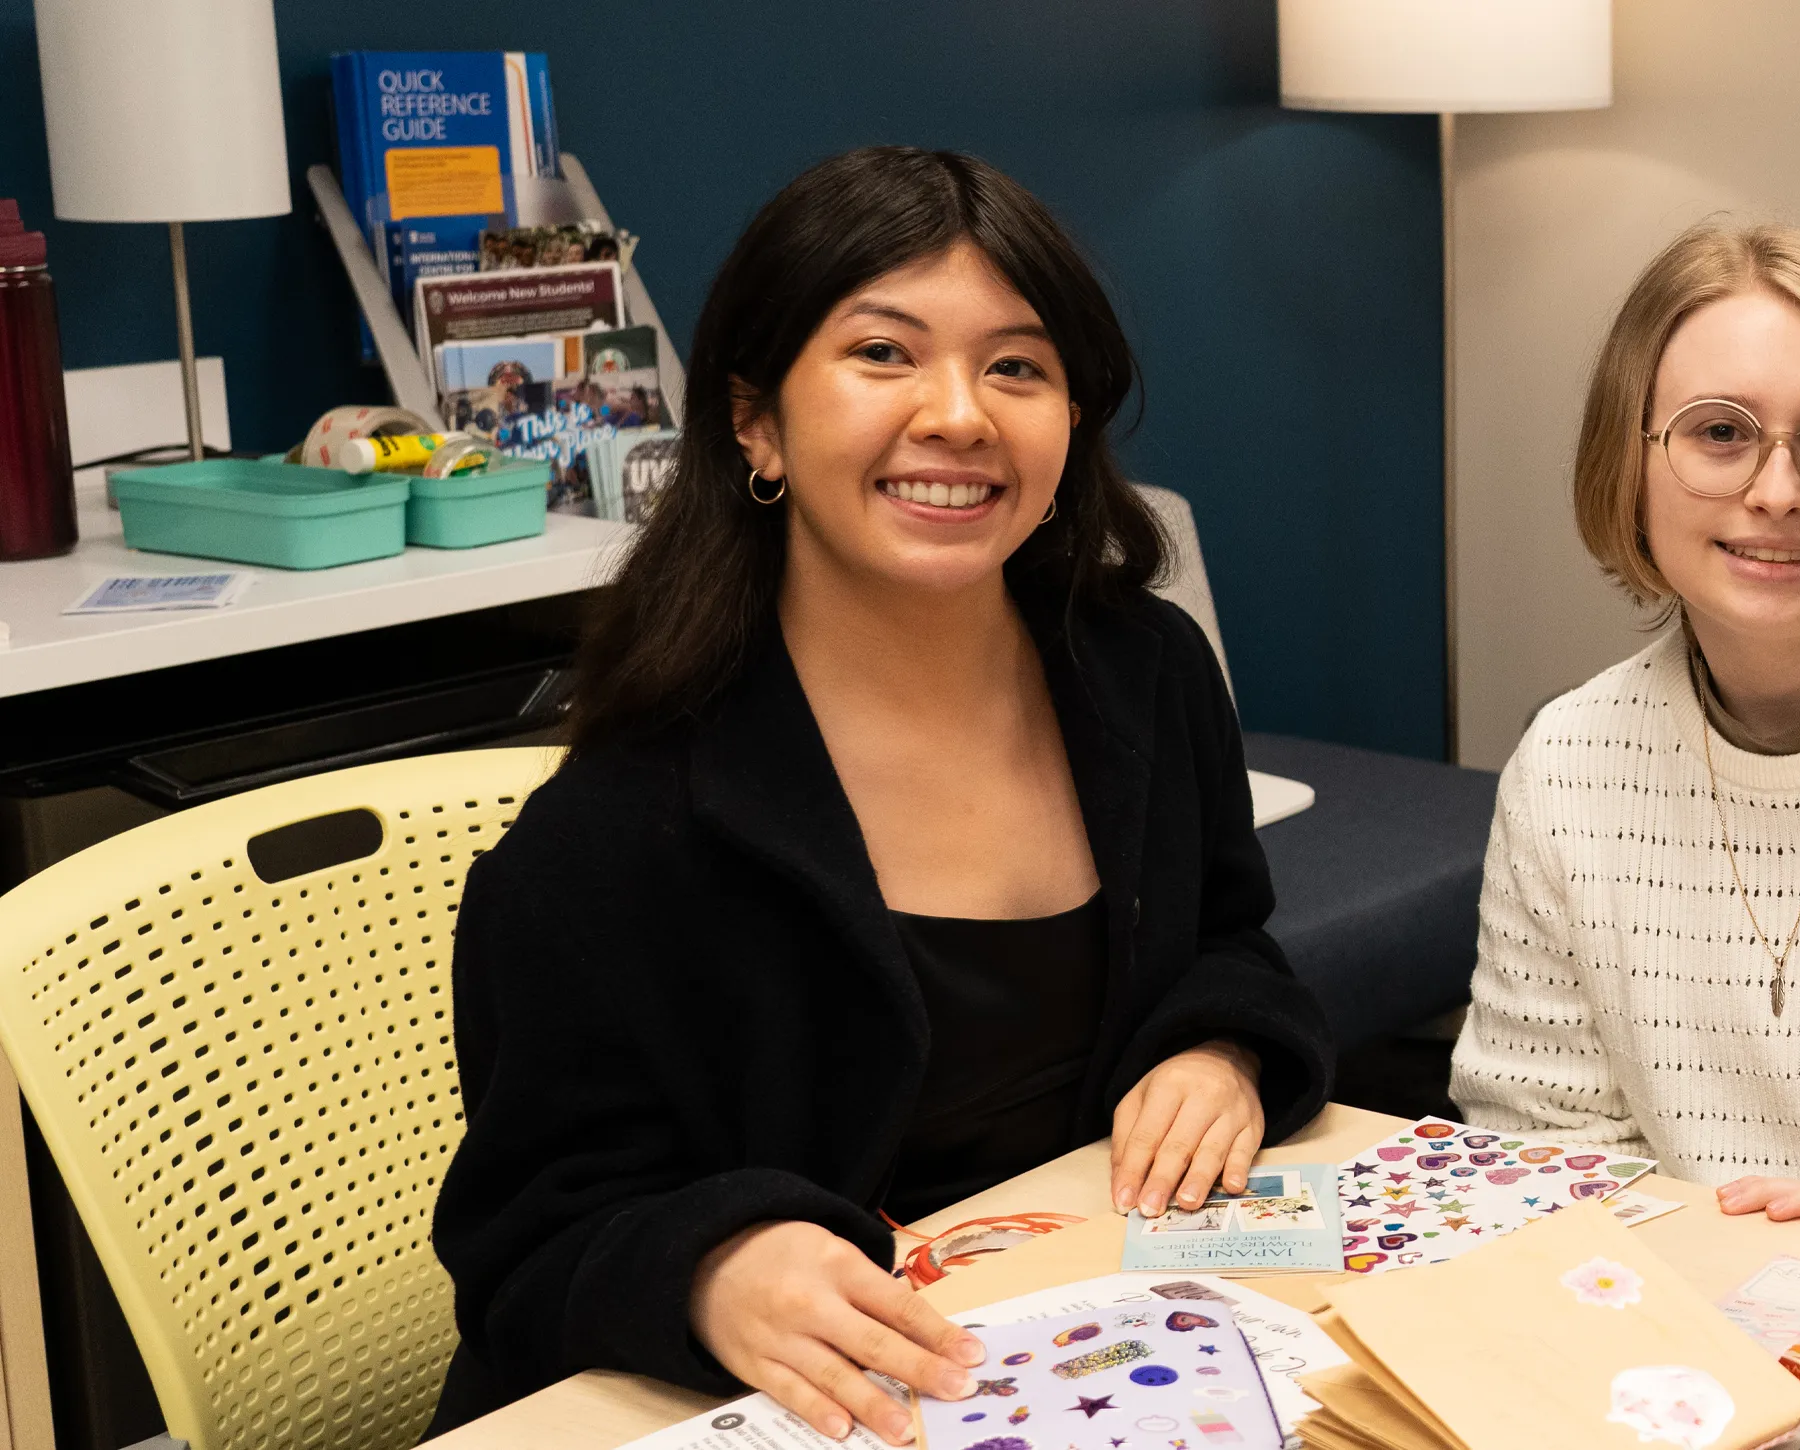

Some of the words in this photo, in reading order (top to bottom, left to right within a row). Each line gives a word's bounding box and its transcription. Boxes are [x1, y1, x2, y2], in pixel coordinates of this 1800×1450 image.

[378, 69, 445, 94] QUICK
[381, 91, 492, 117] REFERENCE
[382, 117, 447, 141] GUIDE
[409, 250, 479, 264] INTERNATIONA
[448, 290, 508, 305] Welcome
[508, 286, 538, 300] New
[539, 279, 595, 297] Students!
[517, 406, 567, 443] This
[570, 401, 592, 425] is
[1173, 1248, 1293, 1259] JAPANESE
[1241, 1240, 1313, 1248] FLOWERS
